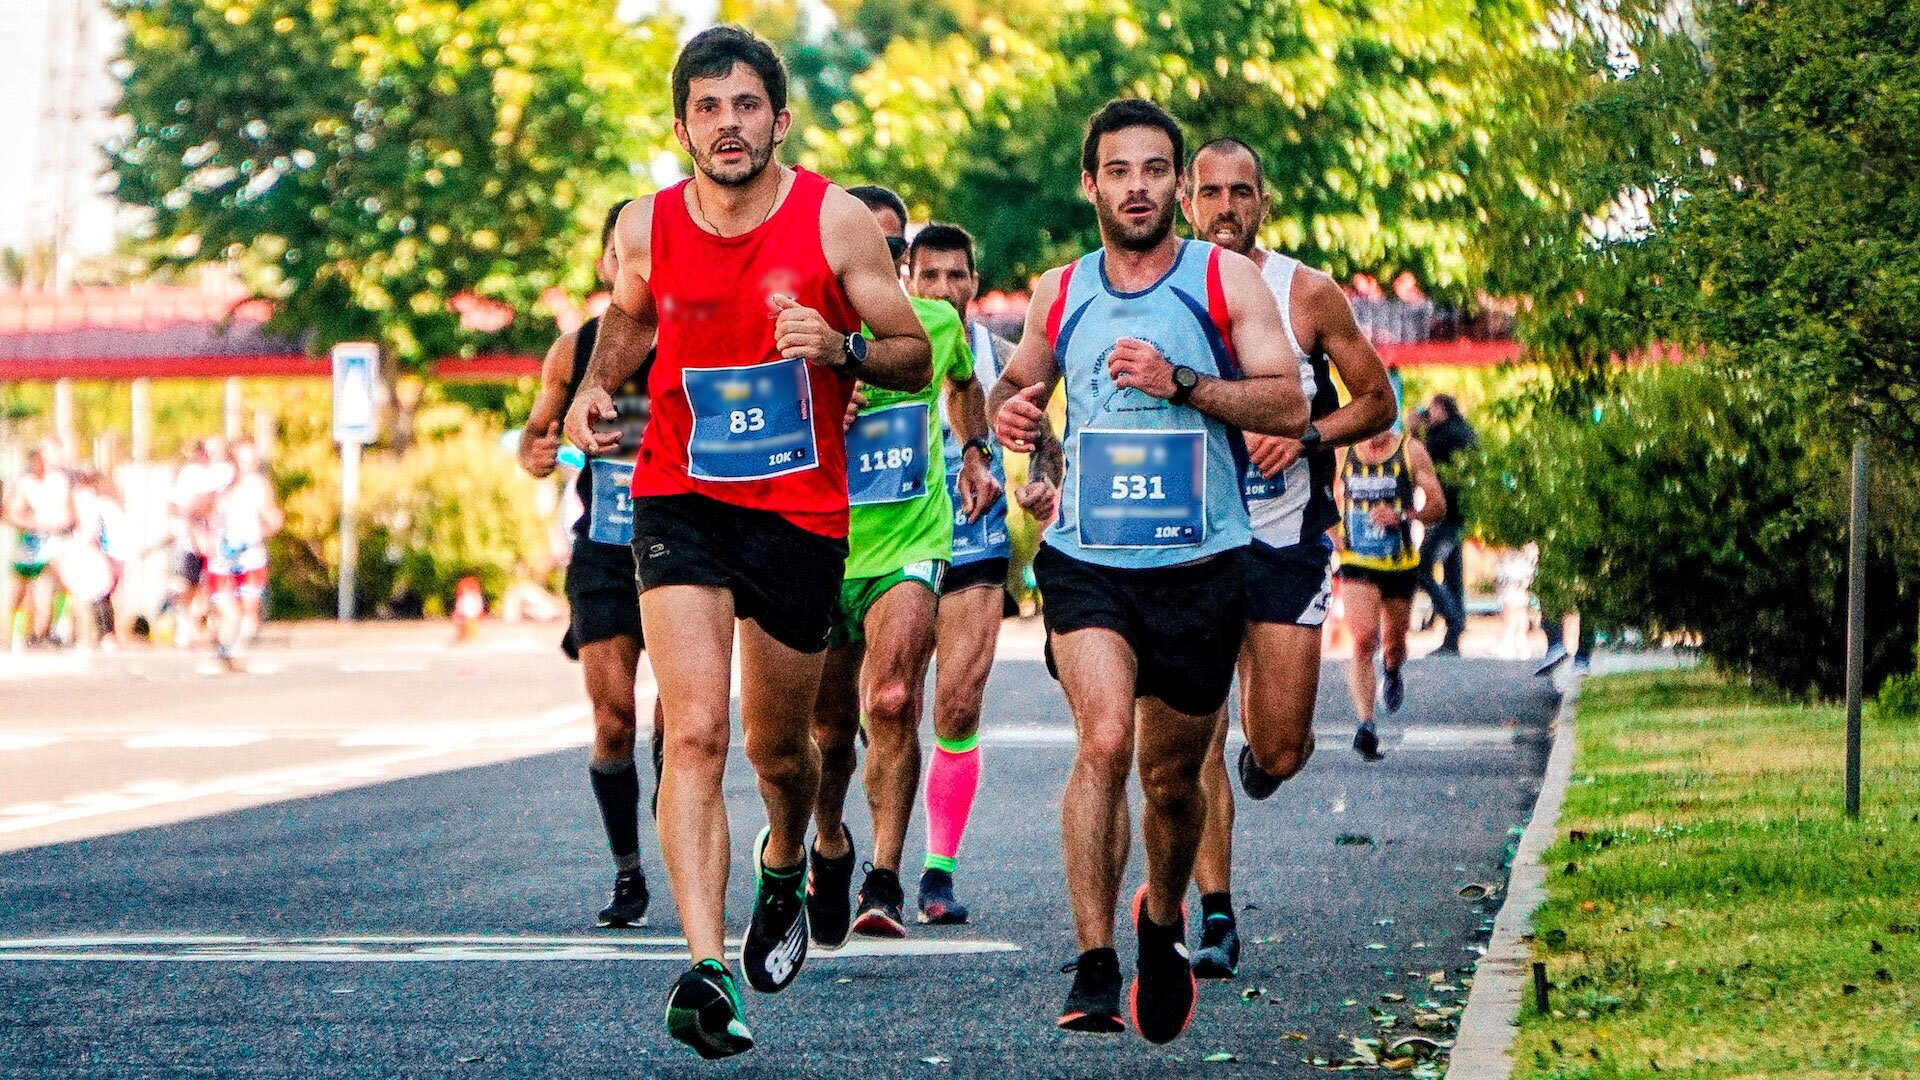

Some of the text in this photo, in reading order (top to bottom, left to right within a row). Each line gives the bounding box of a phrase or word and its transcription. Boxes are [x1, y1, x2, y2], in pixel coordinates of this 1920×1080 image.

[729, 407, 766, 434] 83
[768, 451, 793, 466] 10K
[859, 446, 913, 473] 1189
[1111, 475, 1166, 500] 531
[1245, 484, 1265, 496] 10K
[1154, 526, 1181, 538] 10K
